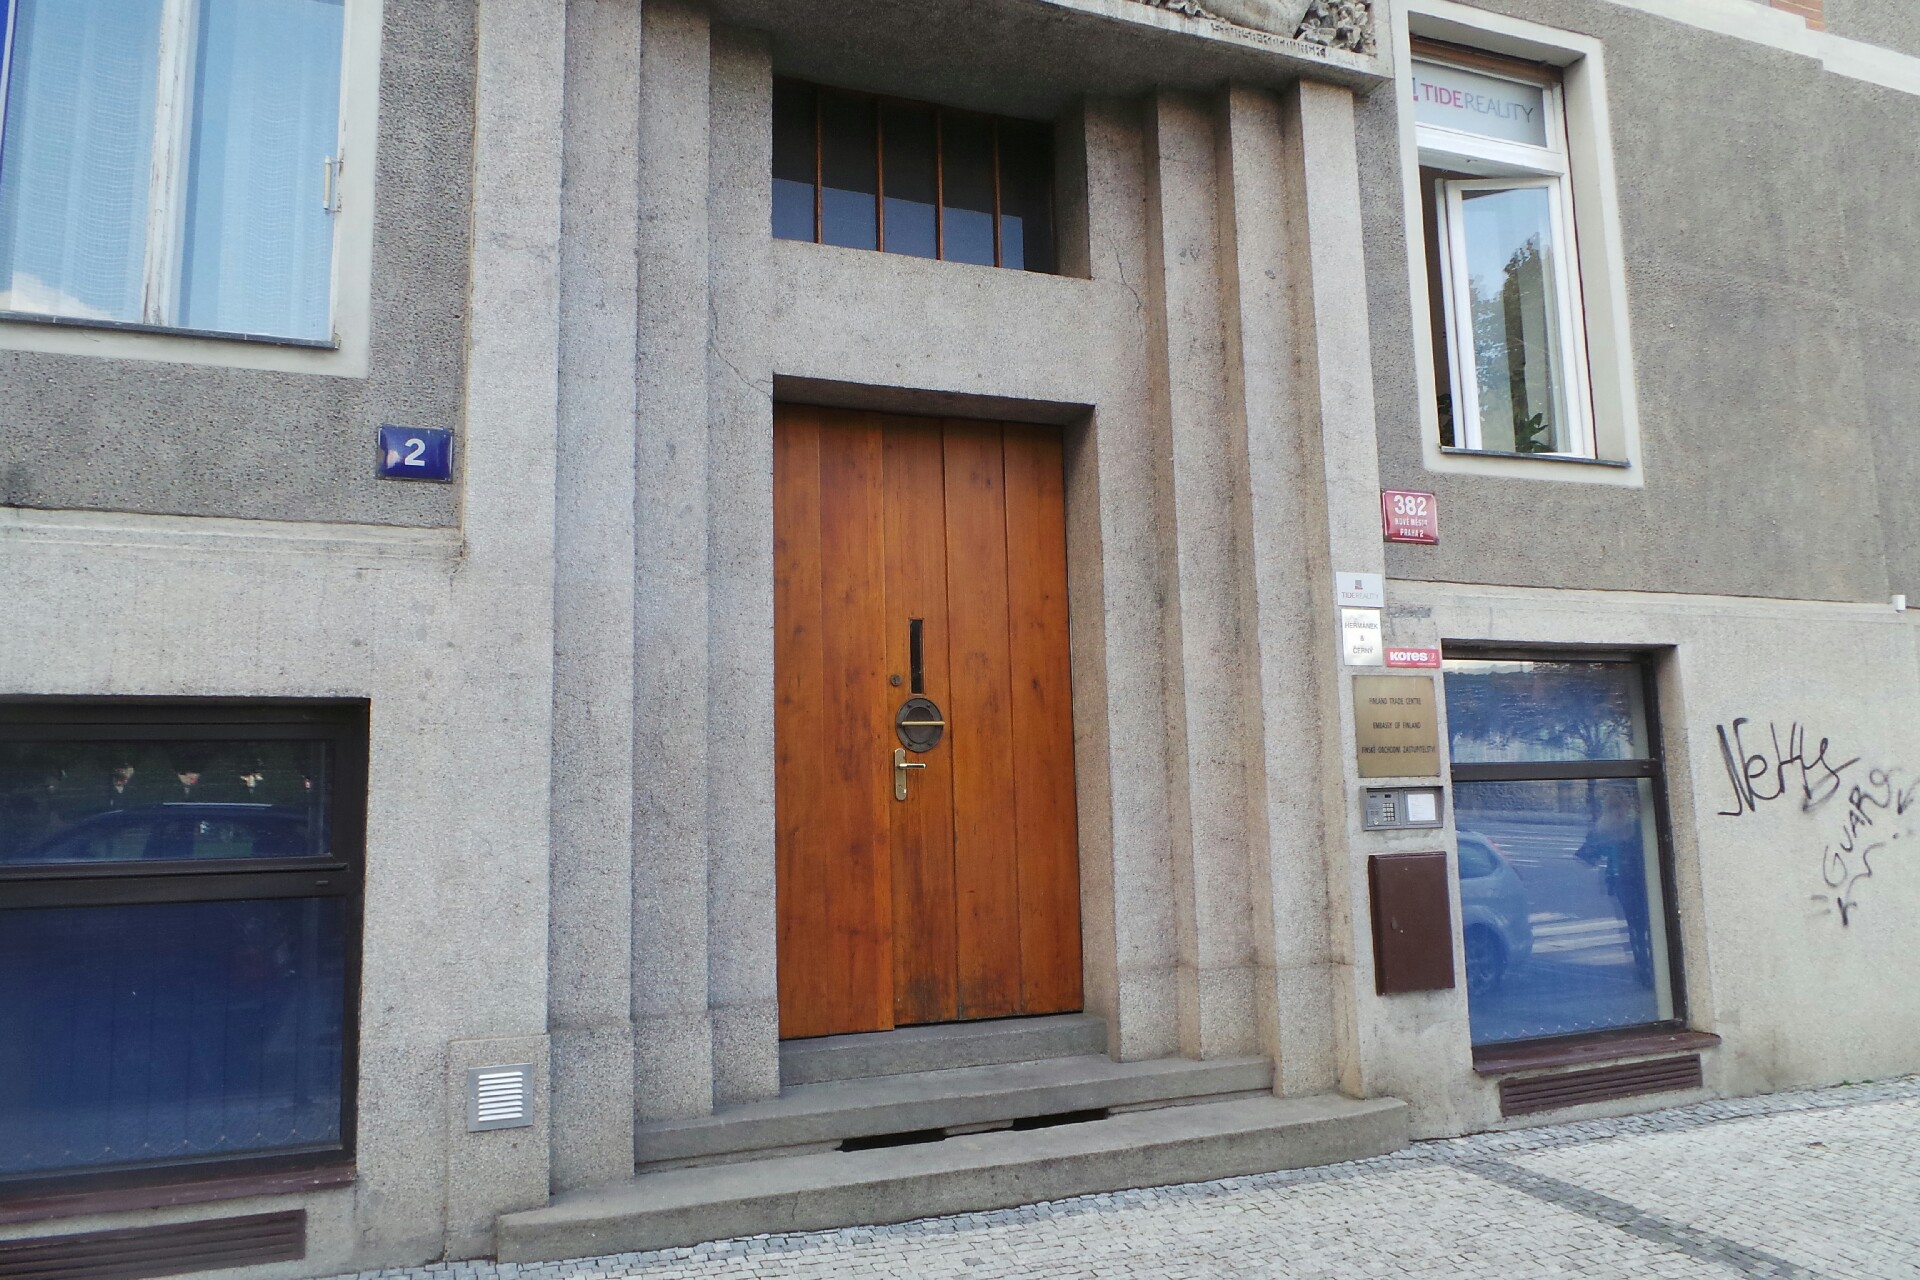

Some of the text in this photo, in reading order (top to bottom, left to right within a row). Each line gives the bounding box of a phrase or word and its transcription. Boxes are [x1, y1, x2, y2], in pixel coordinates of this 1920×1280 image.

[405, 438, 426, 467] 2
[1393, 494, 1427, 516] 382
[1400, 528, 1424, 538] PRAHA 2
[1369, 697, 1387, 705] FINLAND
[1389, 697, 1404, 705] TRADE
